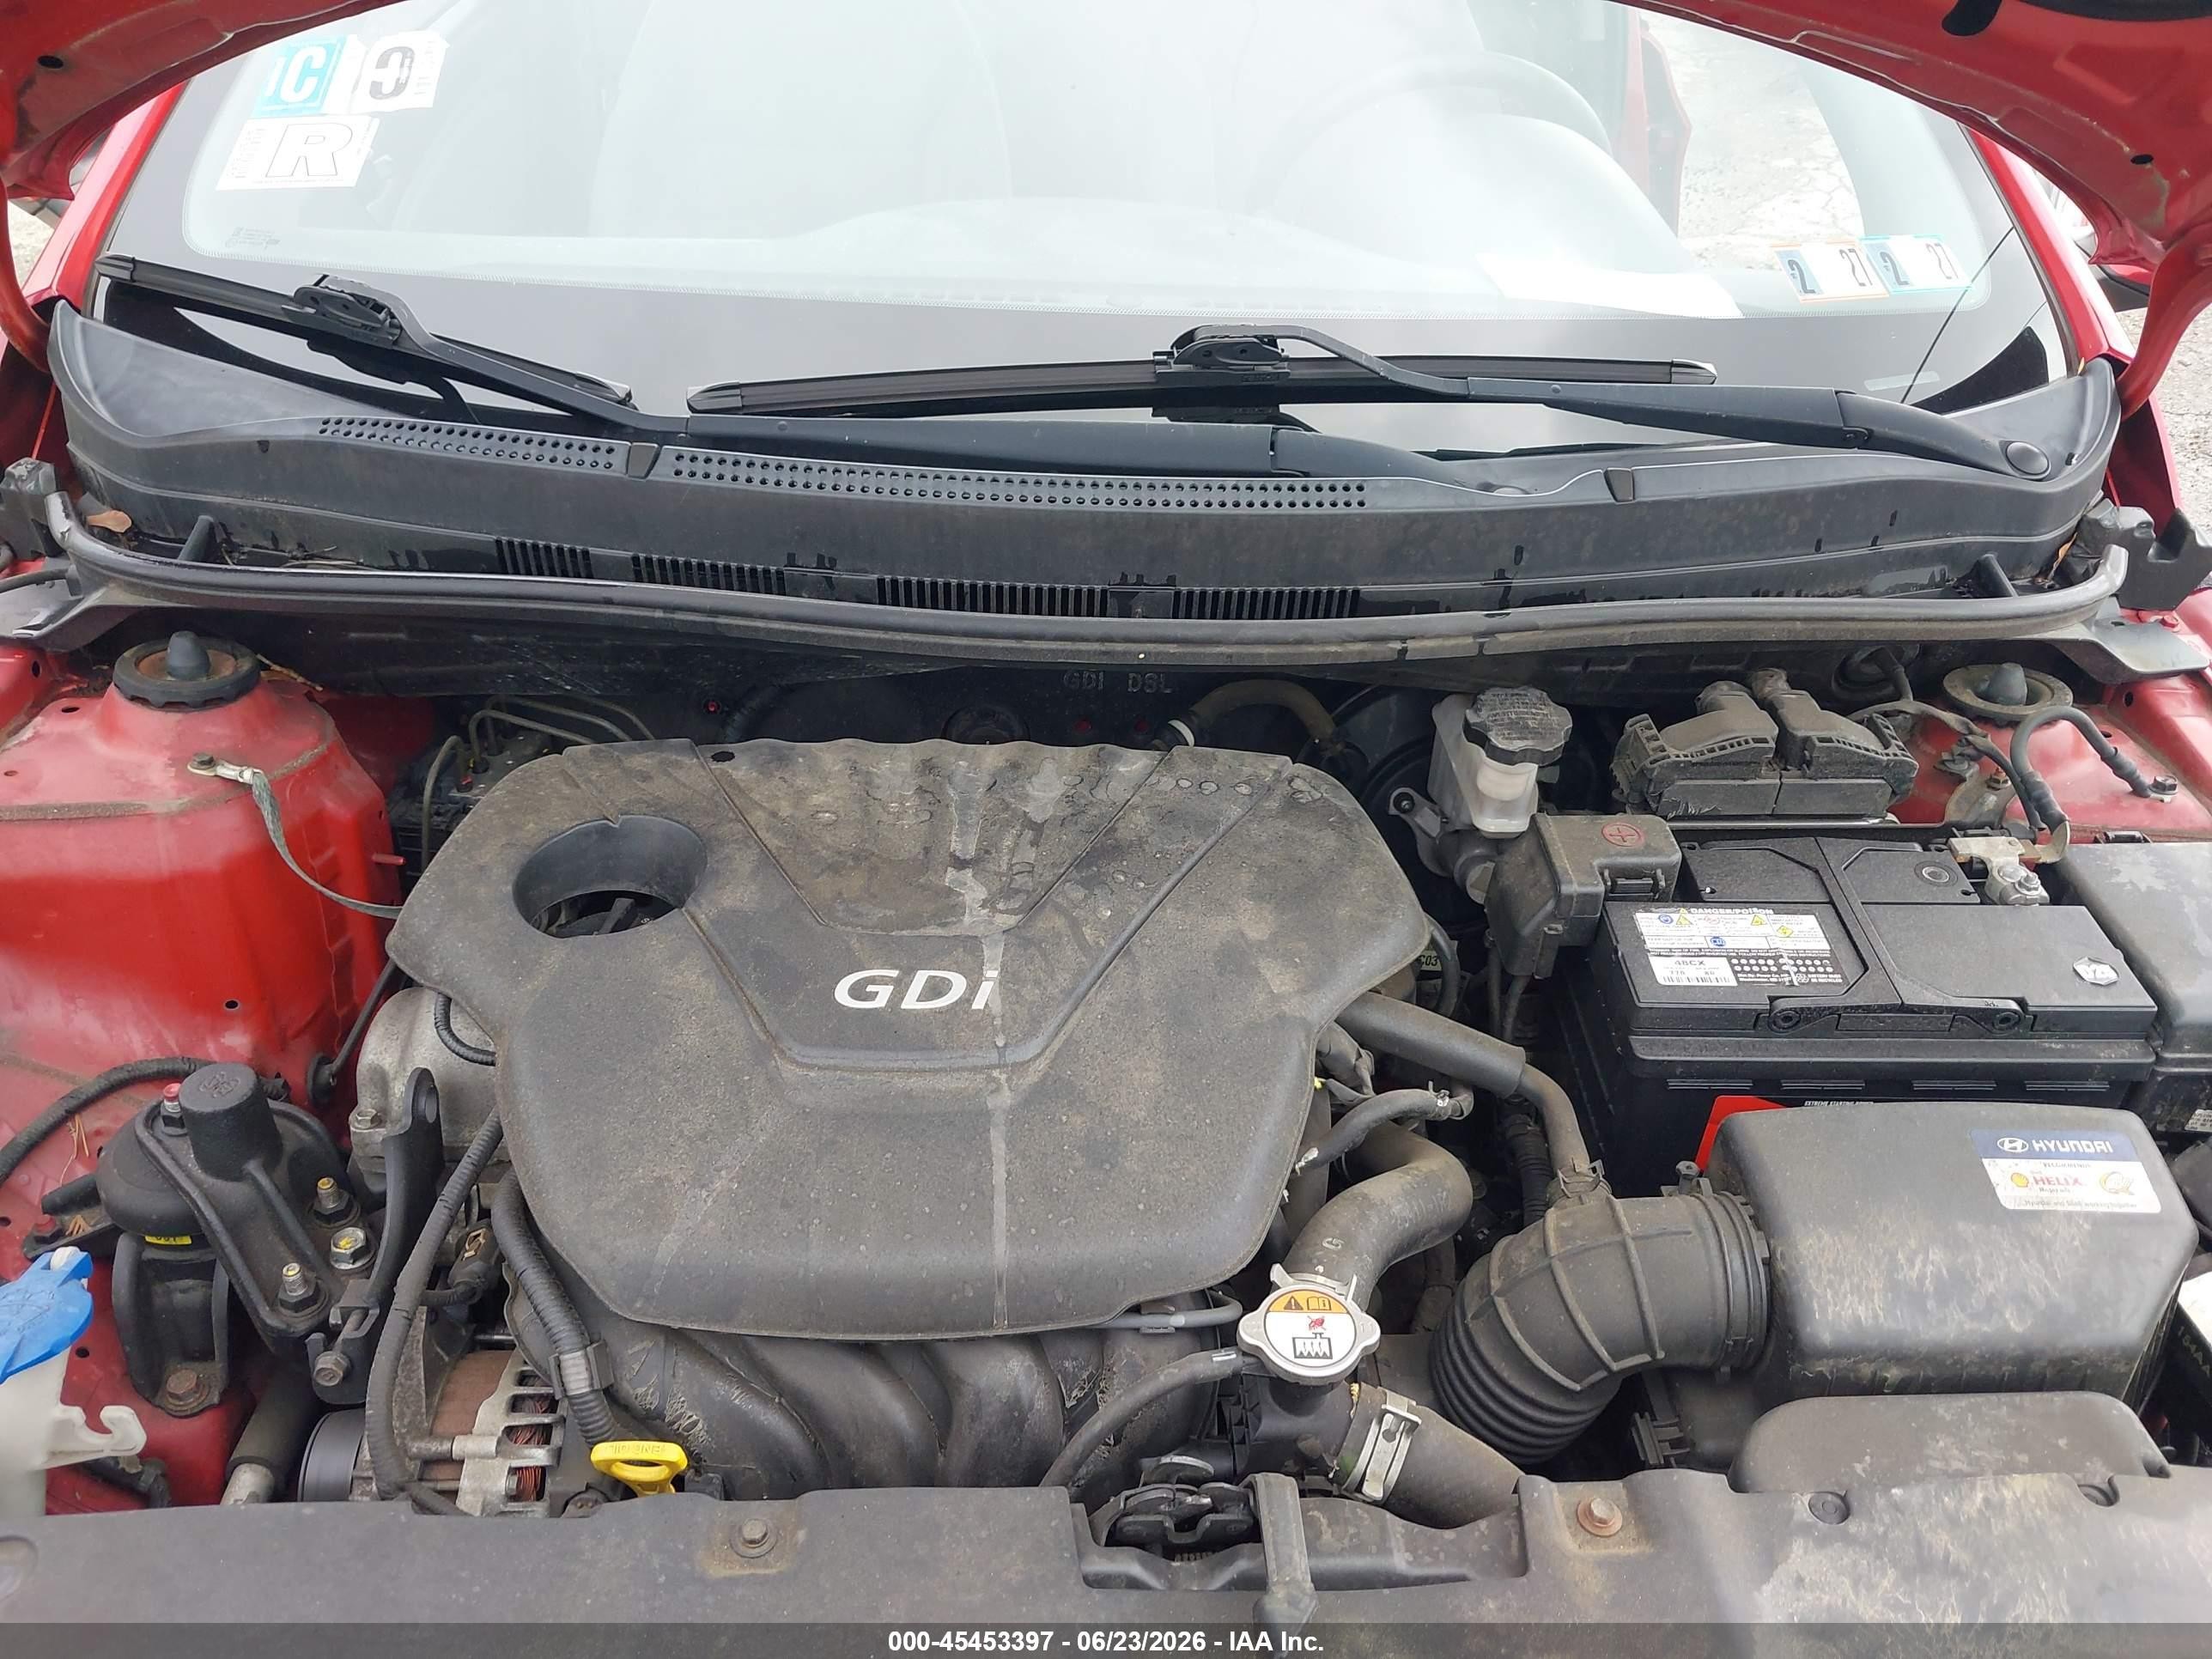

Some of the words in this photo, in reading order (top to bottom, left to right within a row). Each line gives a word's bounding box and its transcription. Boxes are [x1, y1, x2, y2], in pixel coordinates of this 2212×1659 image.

[834, 968, 1000, 1010] GDi
[2032, 1139, 2114, 1153] HYUNDAI
[2033, 1176, 2084, 1186] HELIX
